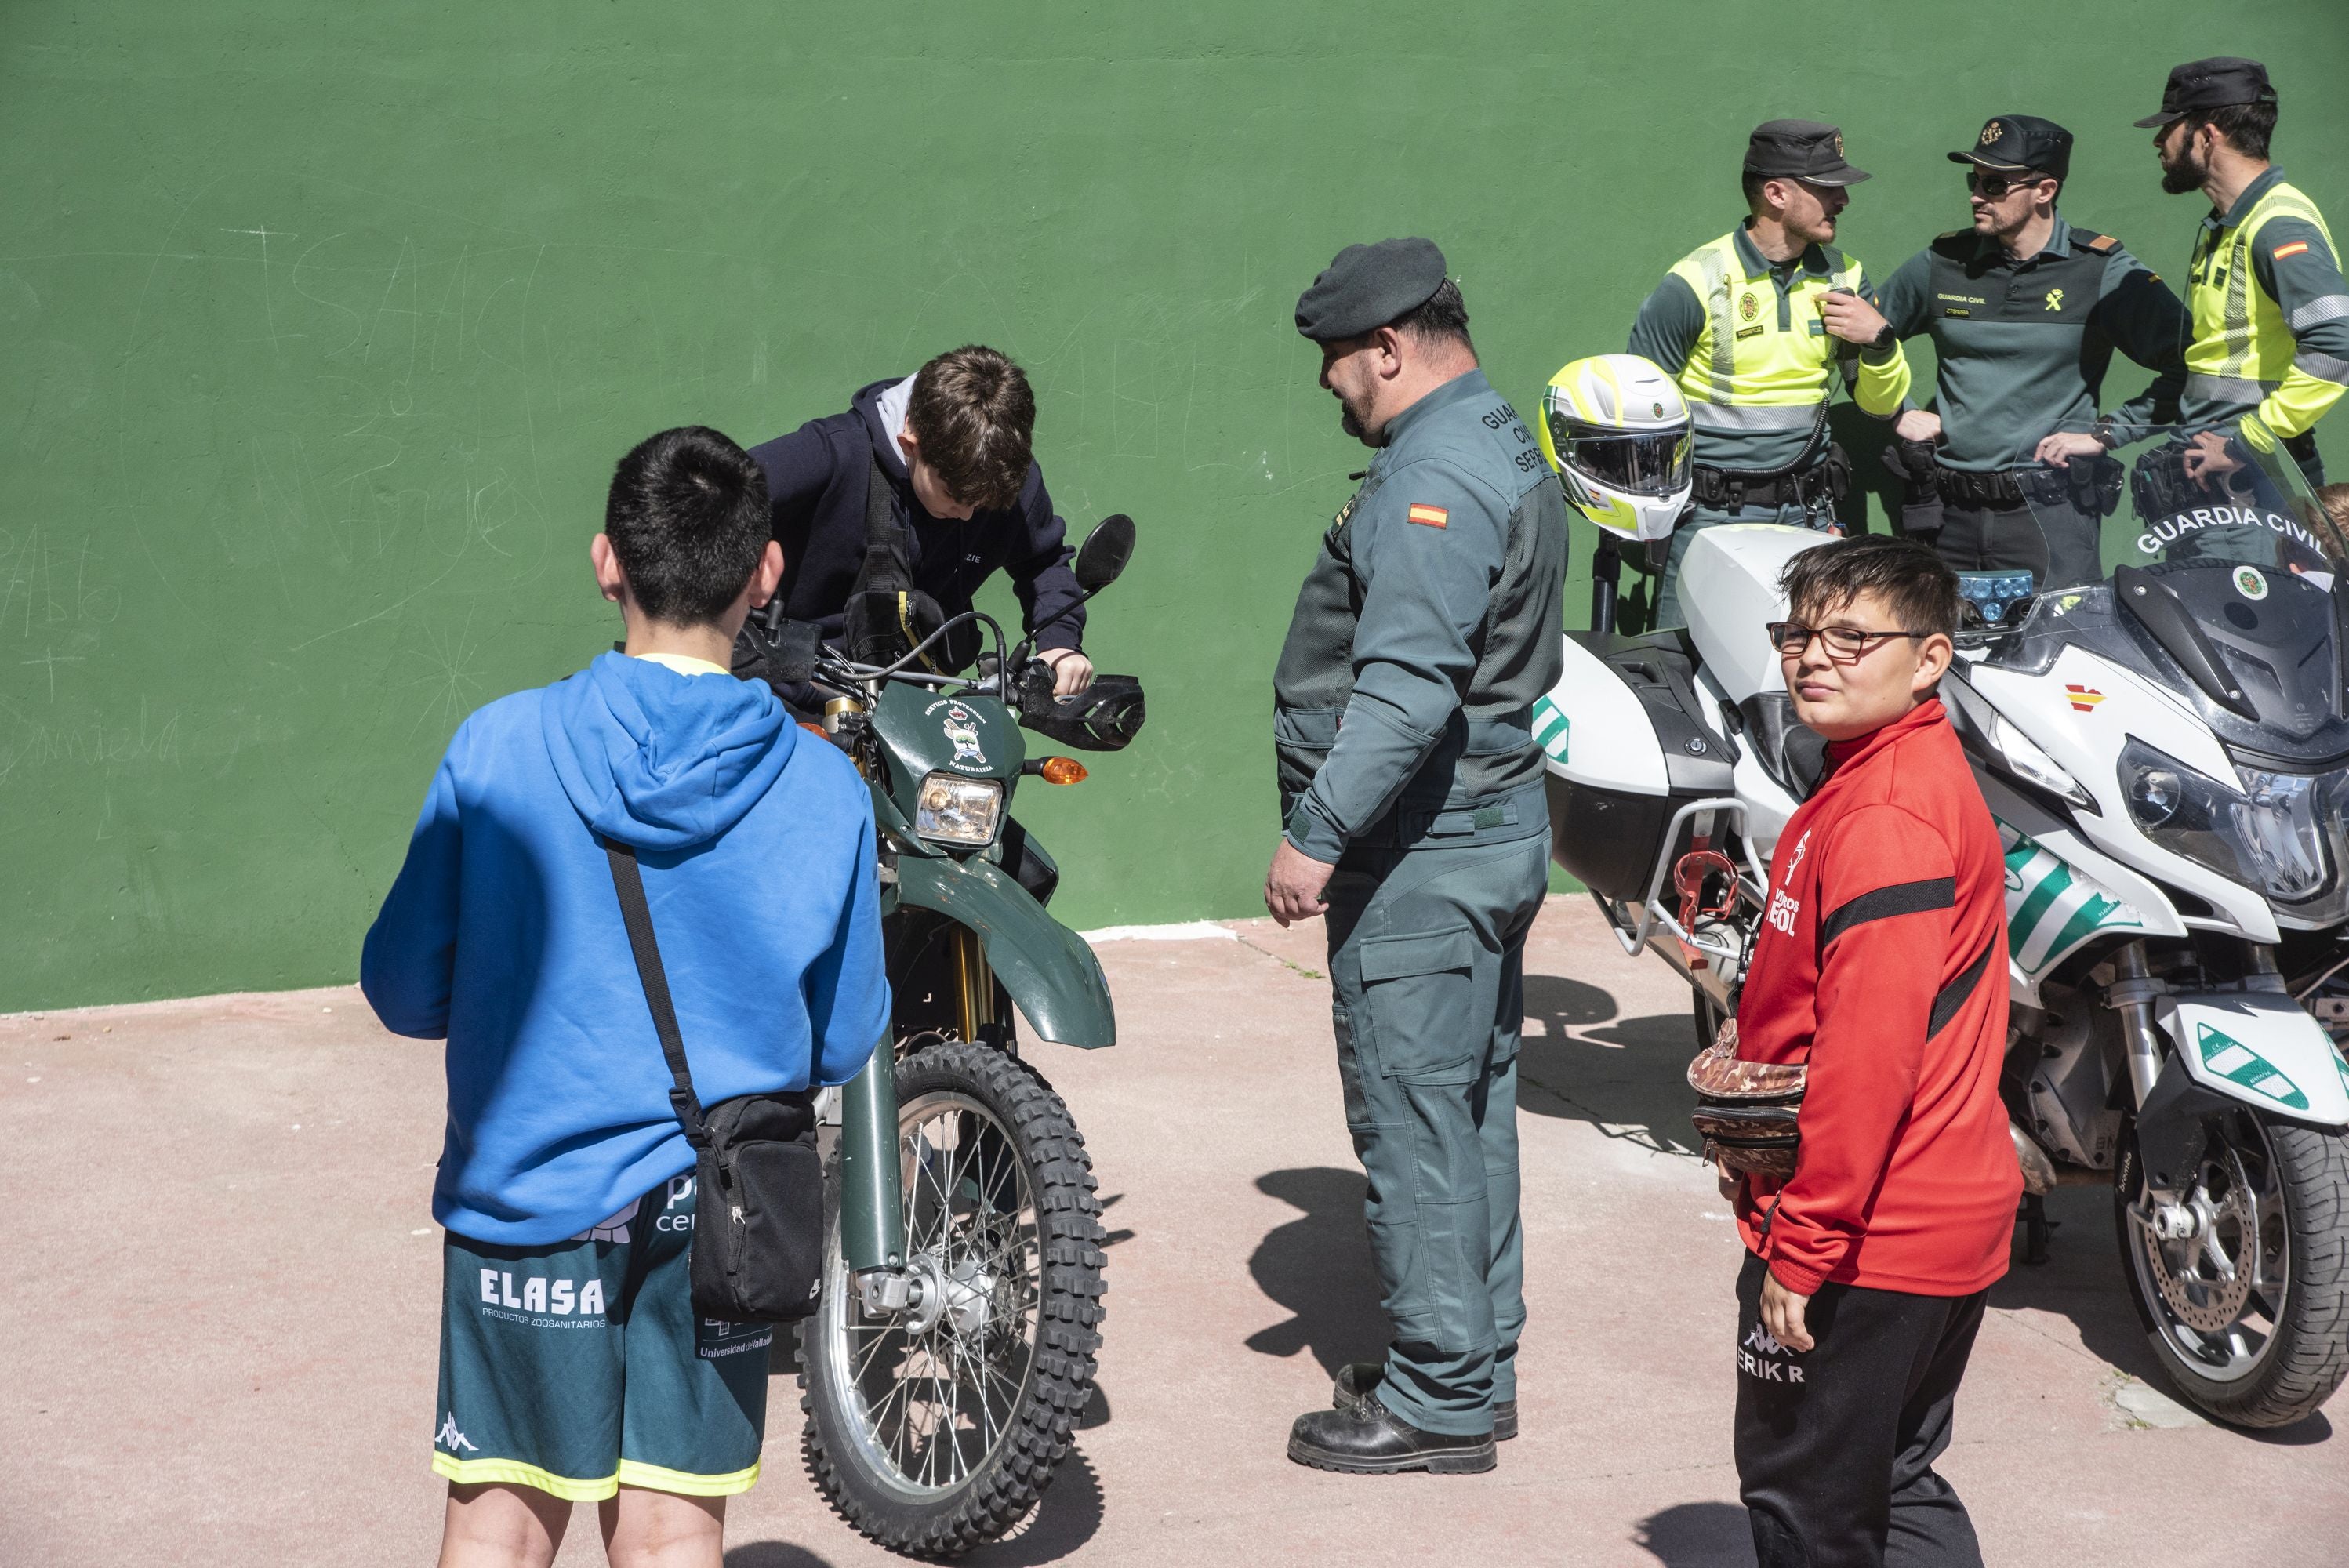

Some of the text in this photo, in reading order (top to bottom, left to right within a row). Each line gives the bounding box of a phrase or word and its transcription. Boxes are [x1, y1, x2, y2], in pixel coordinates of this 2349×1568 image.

[1937, 293, 1987, 305] GUARDIA CIVIL
[2137, 506, 2328, 560] GUARDIA CIVIL
[925, 699, 987, 724] SERVICIO PROTECCION
[949, 760, 993, 773] NATURALEZA
[2118, 1152, 2132, 1192] brembo
[480, 1268, 606, 1316] ELASA
[482, 1308, 606, 1329] PRODUCTOS ZOOSANITARIOS
[700, 1343, 746, 1358] Universidad
[1737, 1345, 1806, 1383] ERIK R
